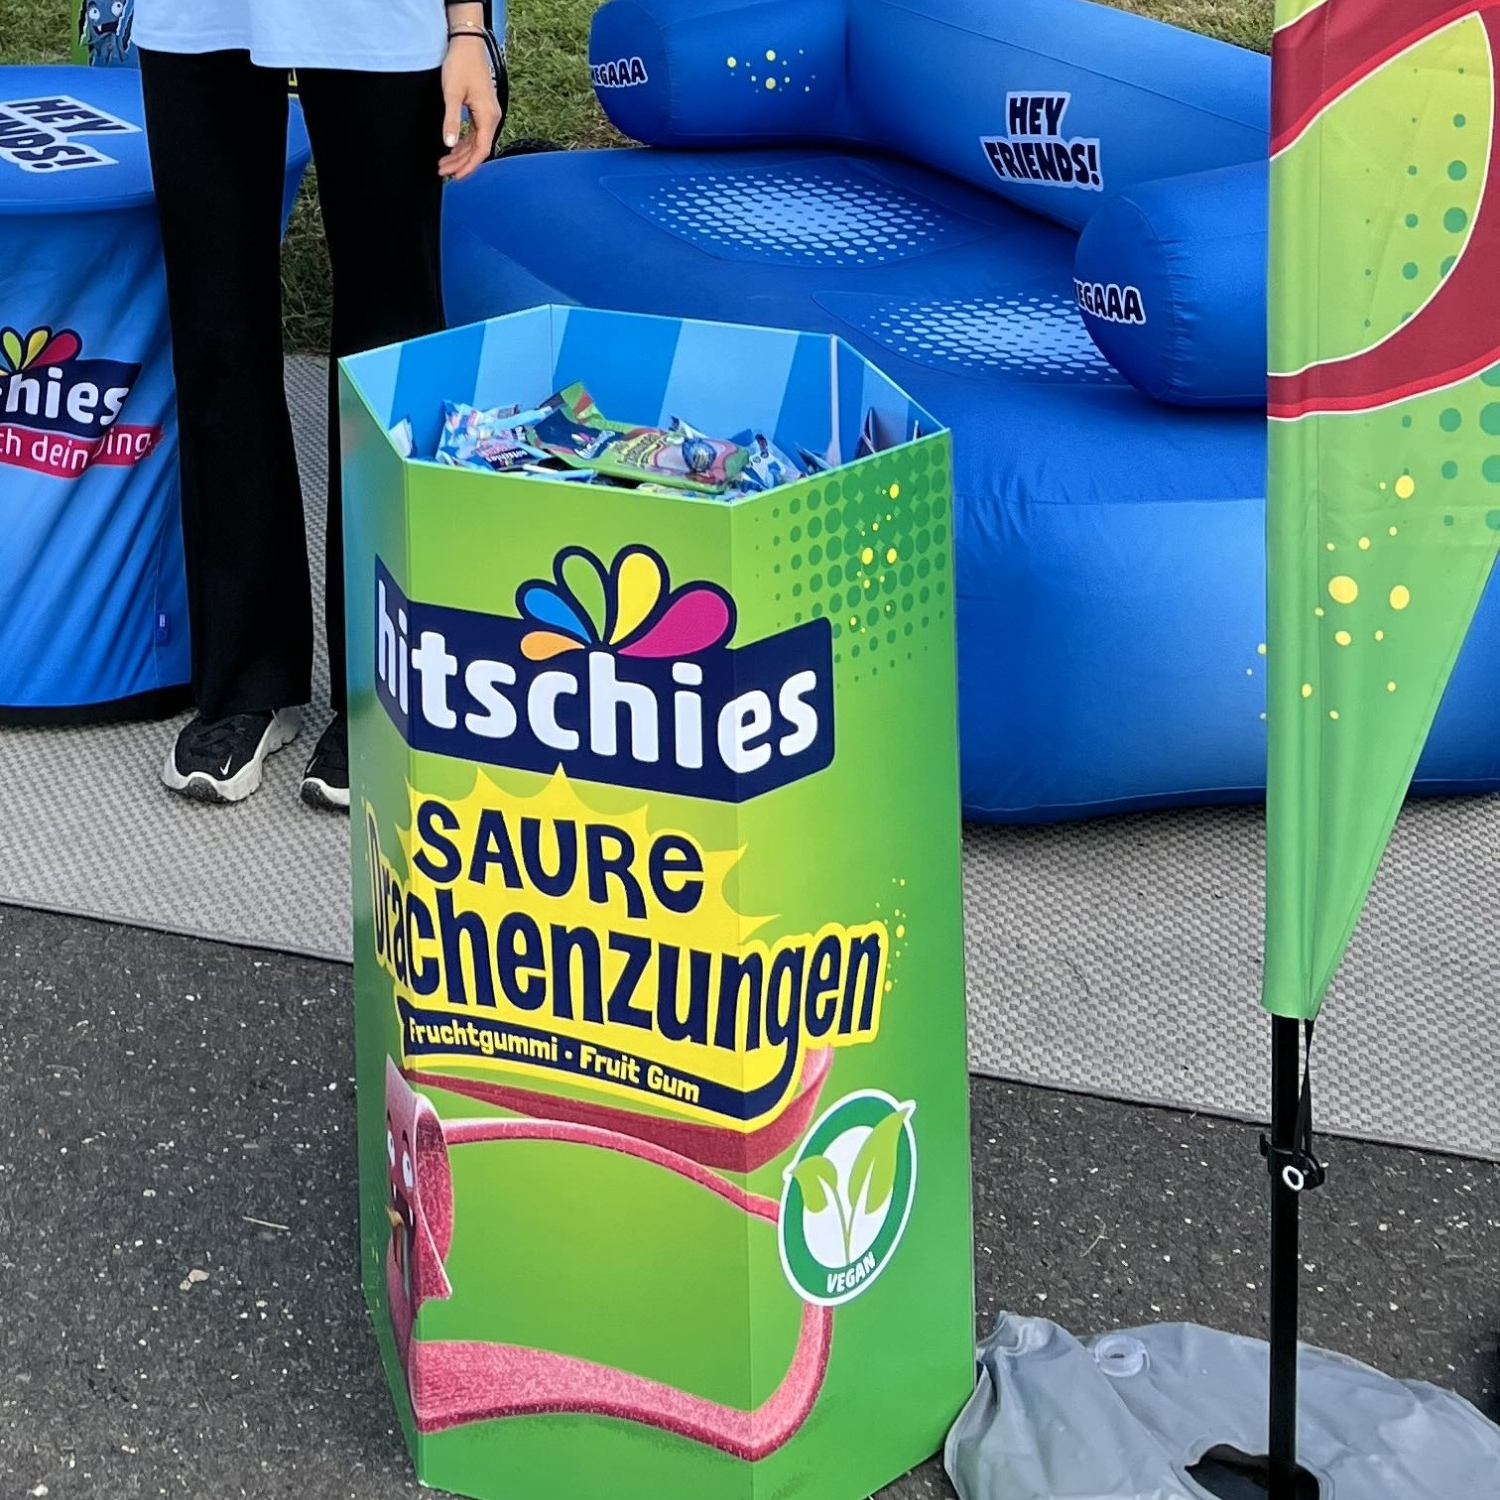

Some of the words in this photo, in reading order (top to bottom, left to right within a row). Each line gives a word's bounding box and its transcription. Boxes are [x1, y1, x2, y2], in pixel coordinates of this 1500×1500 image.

[8, 99, 128, 134] HEY
[1008, 97, 1066, 136] HEY
[985, 141, 1100, 186] FRIENDS!
[32, 436, 88, 470] dein
[378, 580, 818, 772] hitschies
[368, 811, 885, 1075] Drachenzungen
[409, 1017, 558, 1062] Fruchtgummi
[580, 1045, 639, 1084] Fruit
[647, 1070, 700, 1104] Gum
[826, 1251, 876, 1293] VEGAN
